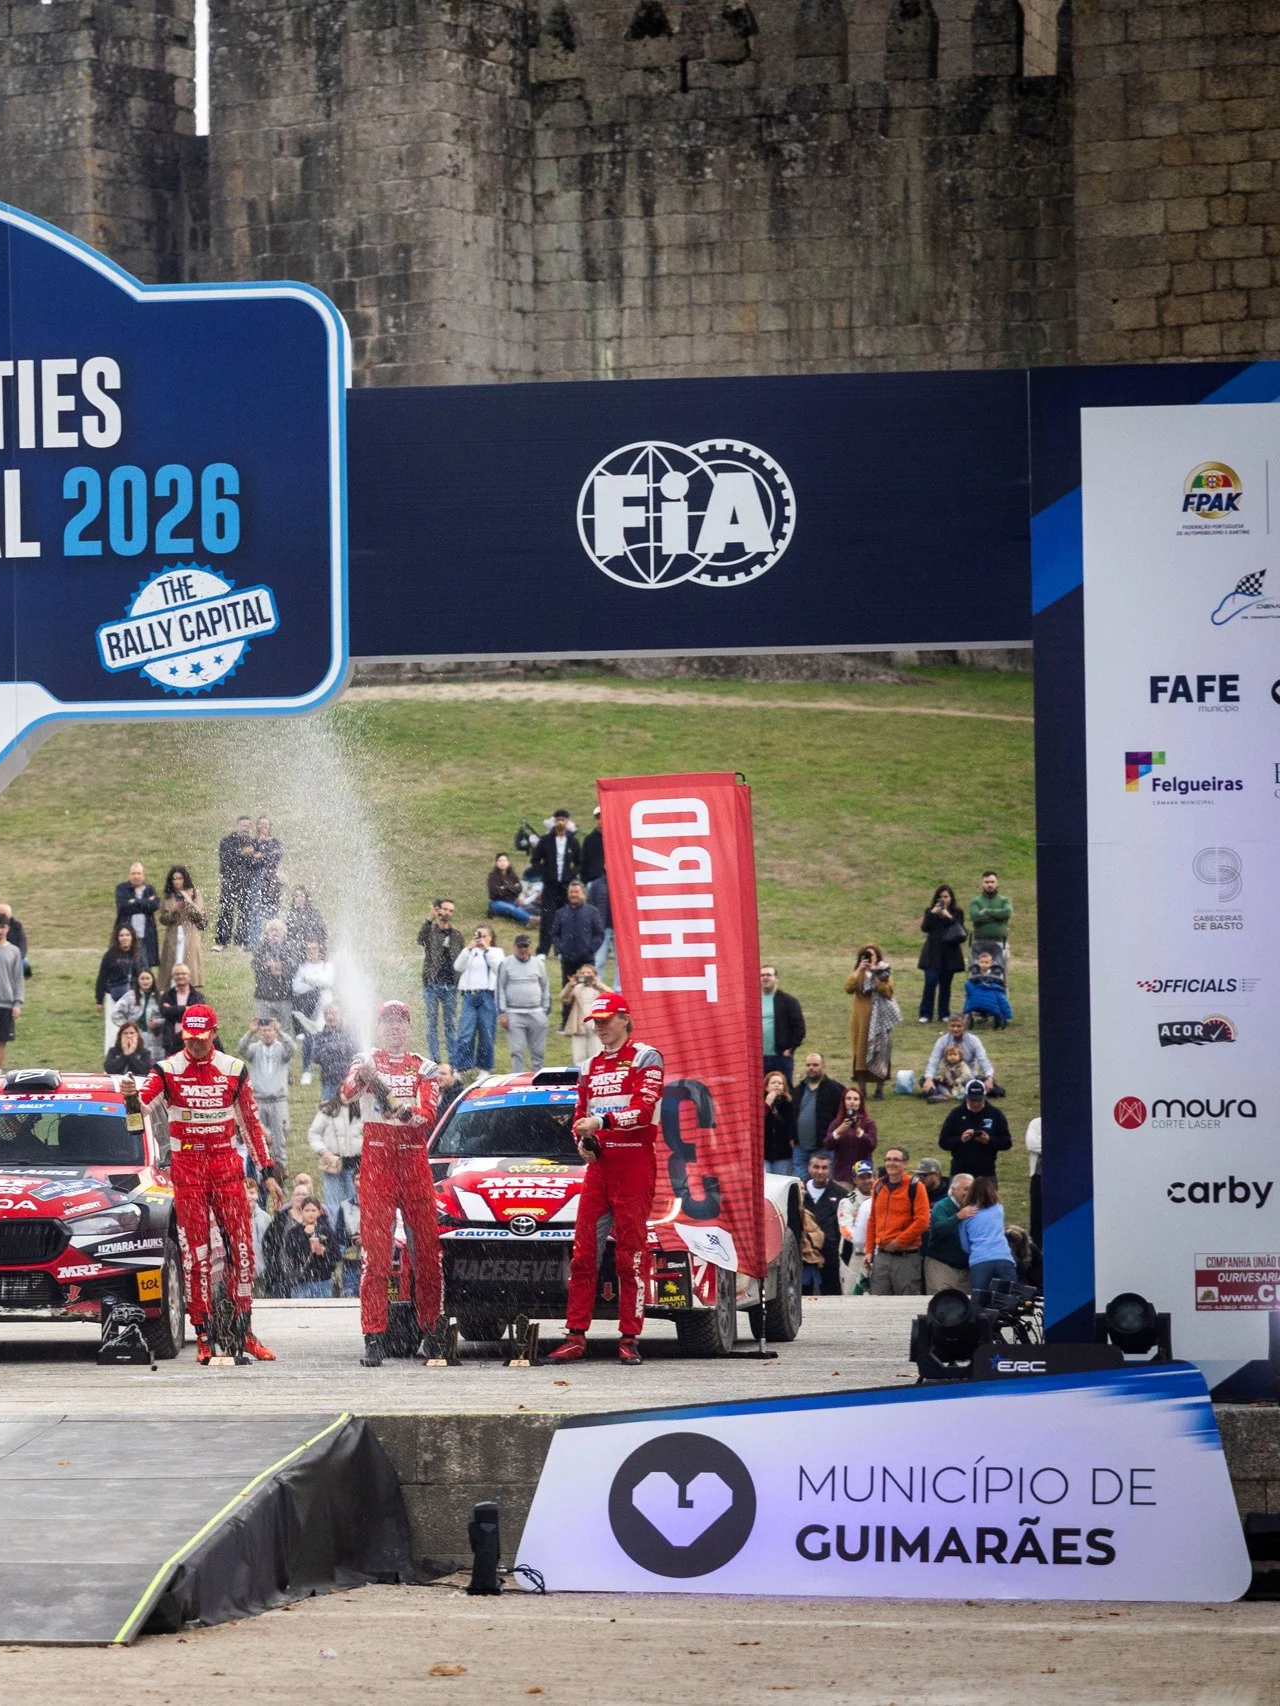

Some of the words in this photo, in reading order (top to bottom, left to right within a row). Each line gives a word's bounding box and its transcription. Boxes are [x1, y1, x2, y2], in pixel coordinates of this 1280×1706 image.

[62, 462, 241, 557] 2026
[1182, 491, 1242, 513] FPAK
[157, 574, 197, 605] THE
[105, 618, 174, 661] RALLY
[178, 596, 272, 643] CAPITAL
[1150, 674, 1240, 703] FAFE
[1198, 703, 1239, 713] município
[1152, 776, 1243, 795] Felgueiras
[1193, 914, 1243, 922] CABECEIRAS
[1193, 922, 1207, 931] DE
[1210, 922, 1244, 930] BASTO
[1151, 978, 1237, 993] OFFICIALS
[1160, 1024, 1204, 1036] ACOR
[588, 1070, 629, 1088] MRF
[180, 1084, 228, 1097] MRF
[186, 1097, 224, 1108] TYRES
[1152, 1098, 1257, 1119] moura
[1151, 1119, 1185, 1129] CORTE
[1187, 1119, 1221, 1129] LASER
[476, 1176, 585, 1188] MRF
[487, 1188, 567, 1199] TYRES
[1167, 1175, 1274, 1209] carby
[97, 1238, 164, 1254] UZVARA-LAUKS
[1206, 1256, 1252, 1268] COMPANHIA
[1253, 1254, 1276, 1268] UNIÃO
[57, 1263, 102, 1278] MRF
[140, 1278, 160, 1291] tet
[798, 1455, 1069, 1505] MUNICÍPIO
[1091, 1467, 1157, 1506] DE
[795, 1516, 1116, 1567] GUIMARÃES
